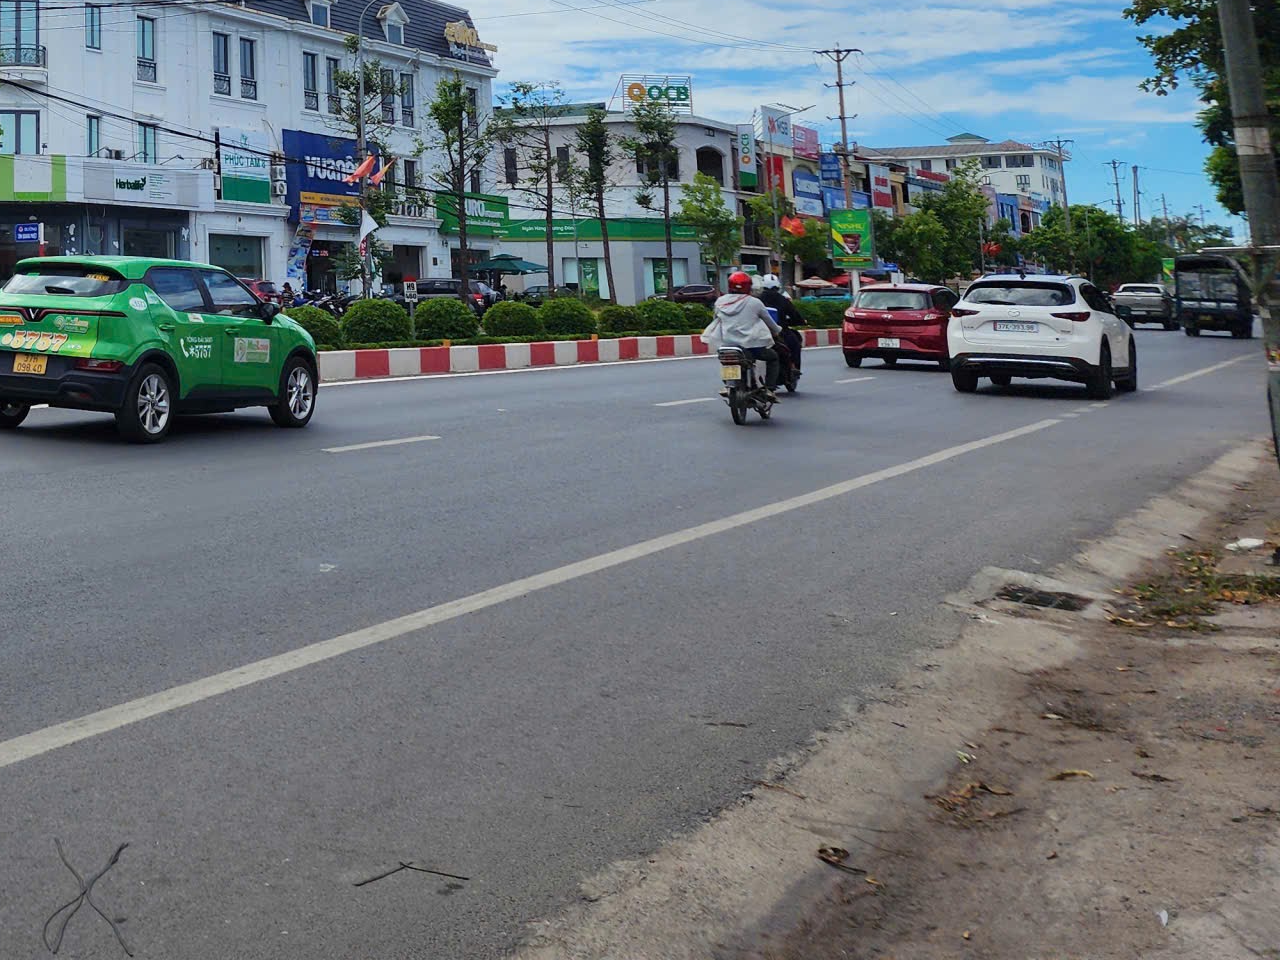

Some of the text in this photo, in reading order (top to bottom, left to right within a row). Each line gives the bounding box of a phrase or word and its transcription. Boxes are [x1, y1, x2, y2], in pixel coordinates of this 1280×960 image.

[647, 85, 689, 101] OCB
[741, 133, 750, 155] OCB
[464, 198, 486, 218] URO
